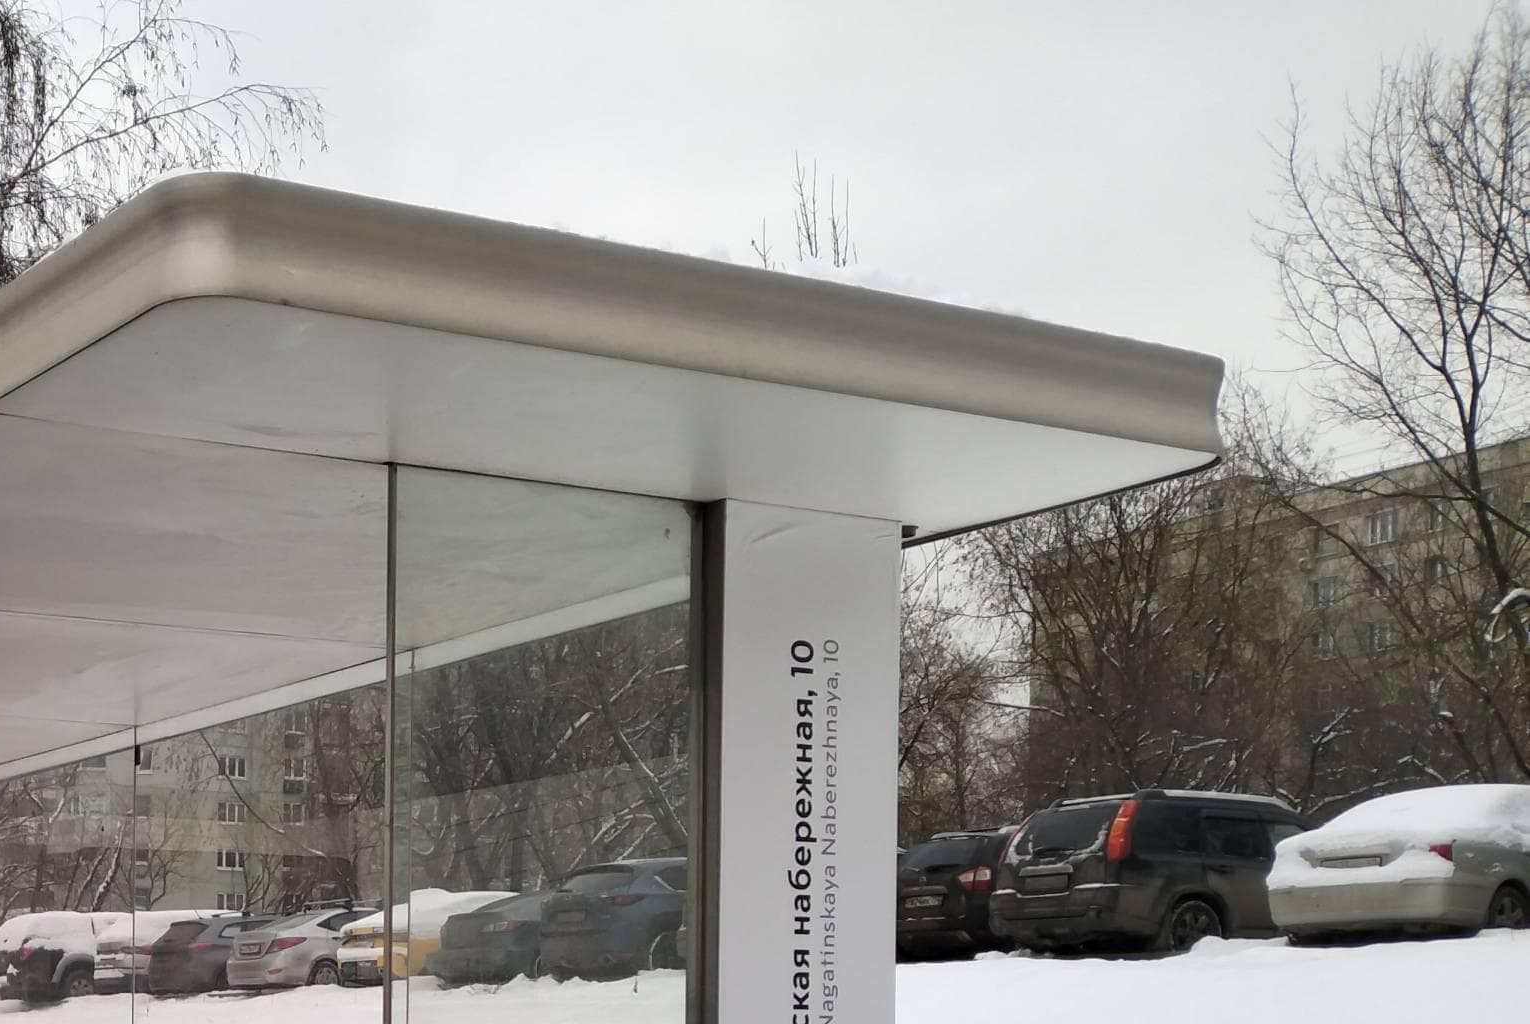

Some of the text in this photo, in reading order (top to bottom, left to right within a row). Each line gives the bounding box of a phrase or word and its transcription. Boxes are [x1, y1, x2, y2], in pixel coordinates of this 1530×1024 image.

[790, 639, 814, 678] 10
[823, 639, 839, 663] 10
[787, 690, 818, 935] набережная,
[820, 671, 842, 855] Naberezhnaya,
